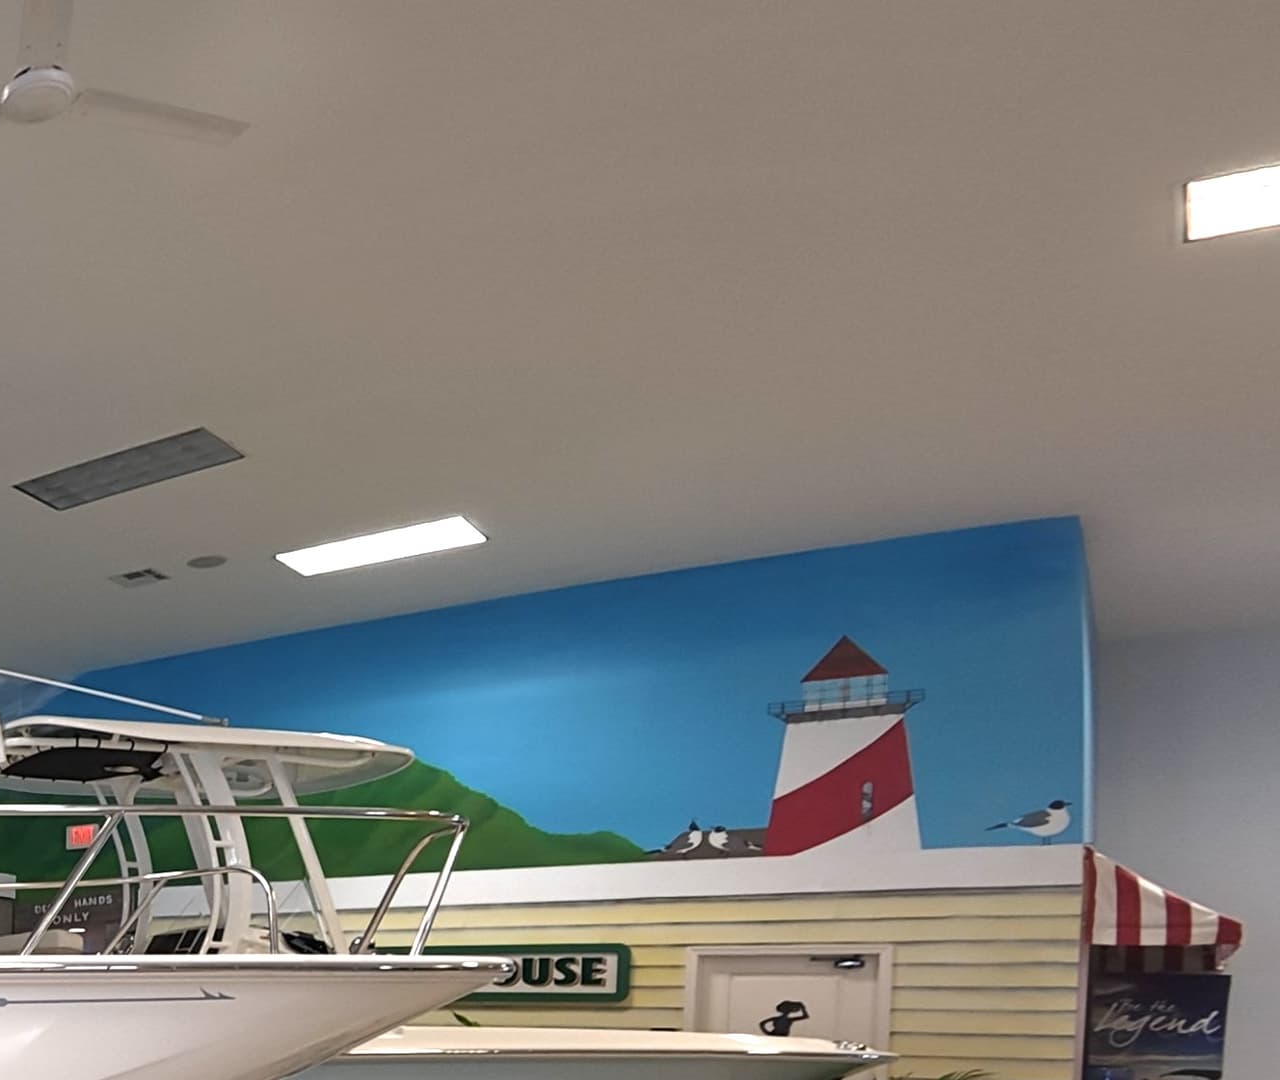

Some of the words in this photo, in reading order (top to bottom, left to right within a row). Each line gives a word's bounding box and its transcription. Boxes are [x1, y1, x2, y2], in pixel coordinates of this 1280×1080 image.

[74, 895, 113, 908] HANDS
[53, 912, 90, 925] ONLY
[1093, 1002, 1221, 1048] Legend
